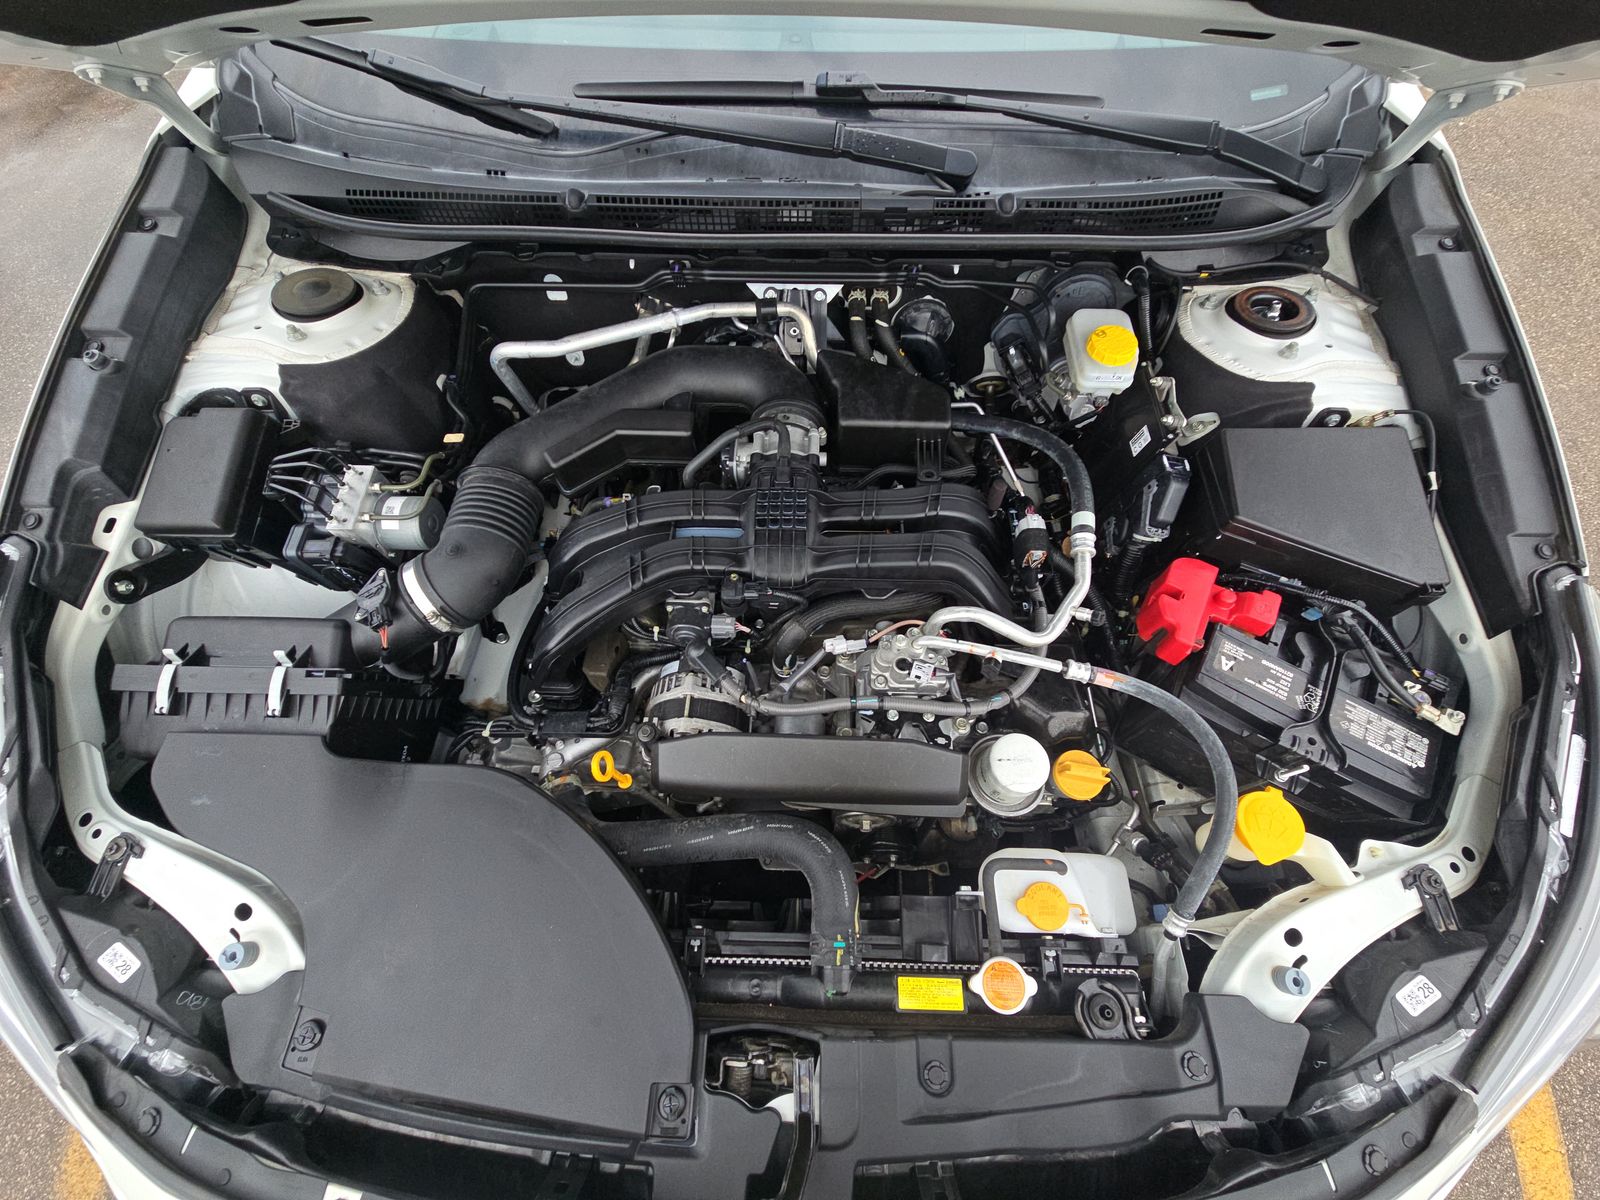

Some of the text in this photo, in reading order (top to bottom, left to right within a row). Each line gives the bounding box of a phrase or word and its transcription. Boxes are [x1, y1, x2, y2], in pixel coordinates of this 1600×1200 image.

[1027, 884, 1063, 900] COOLANT
[115, 959, 132, 975] 28
[1417, 982, 1435, 999] 28
